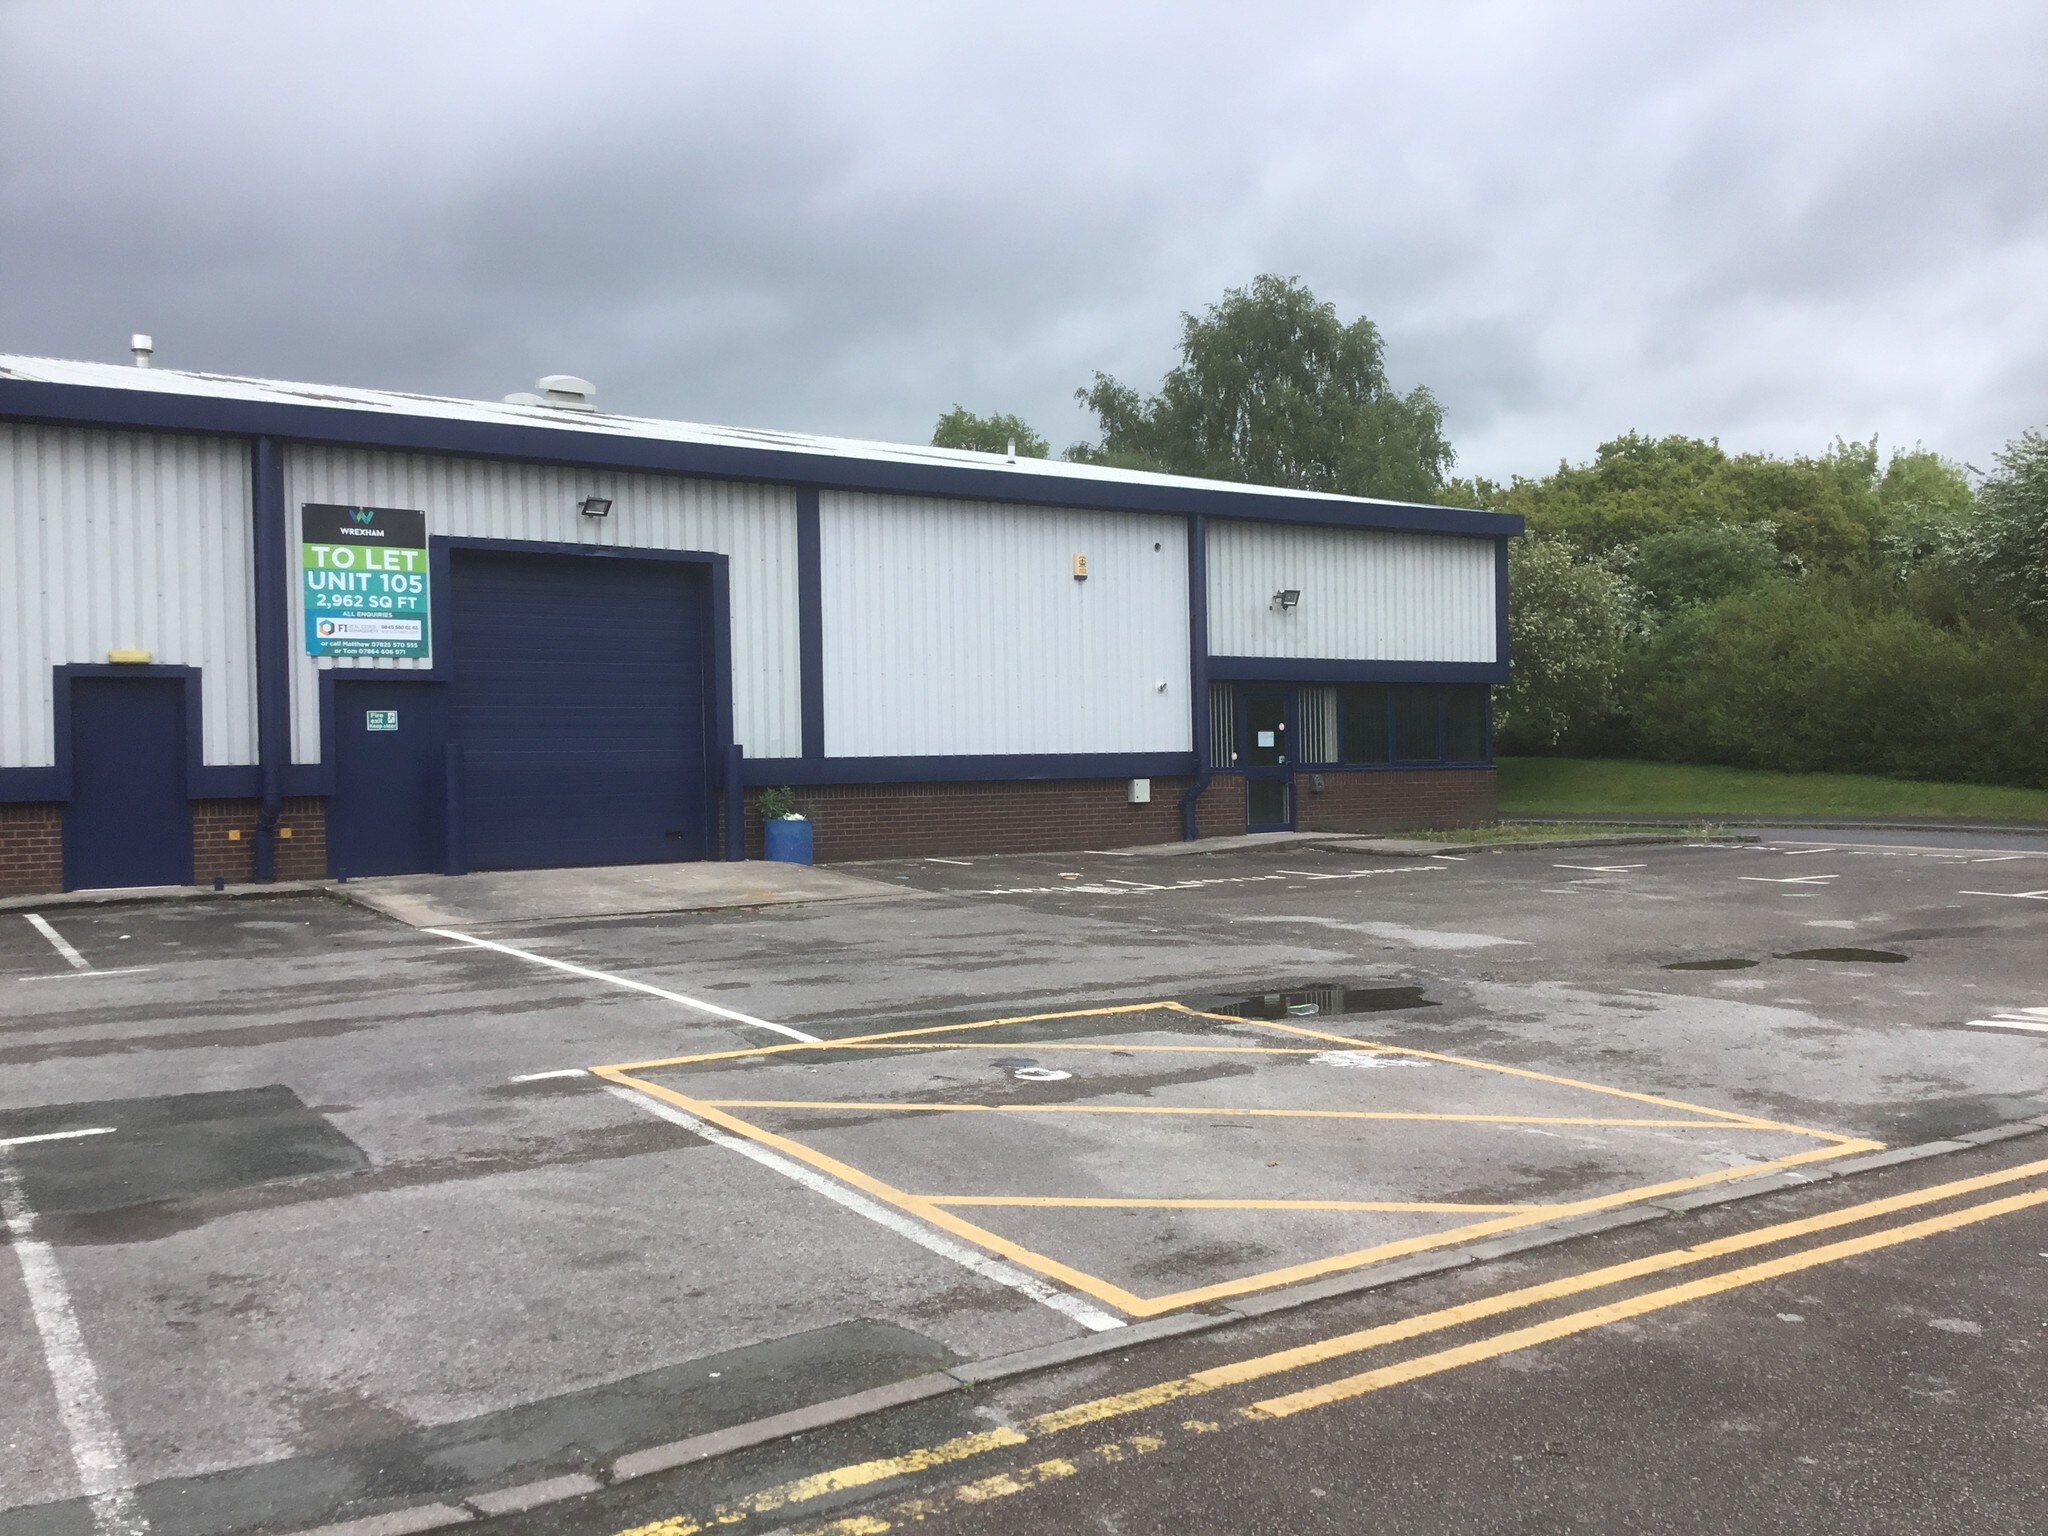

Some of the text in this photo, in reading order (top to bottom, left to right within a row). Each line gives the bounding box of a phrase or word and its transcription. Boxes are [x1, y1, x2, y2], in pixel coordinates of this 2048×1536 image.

[340, 527, 384, 537] WREXHAM
[311, 546, 418, 571] TO LET
[308, 570, 423, 594] UNIT 105
[316, 593, 418, 609] 2,962 SQ FT
